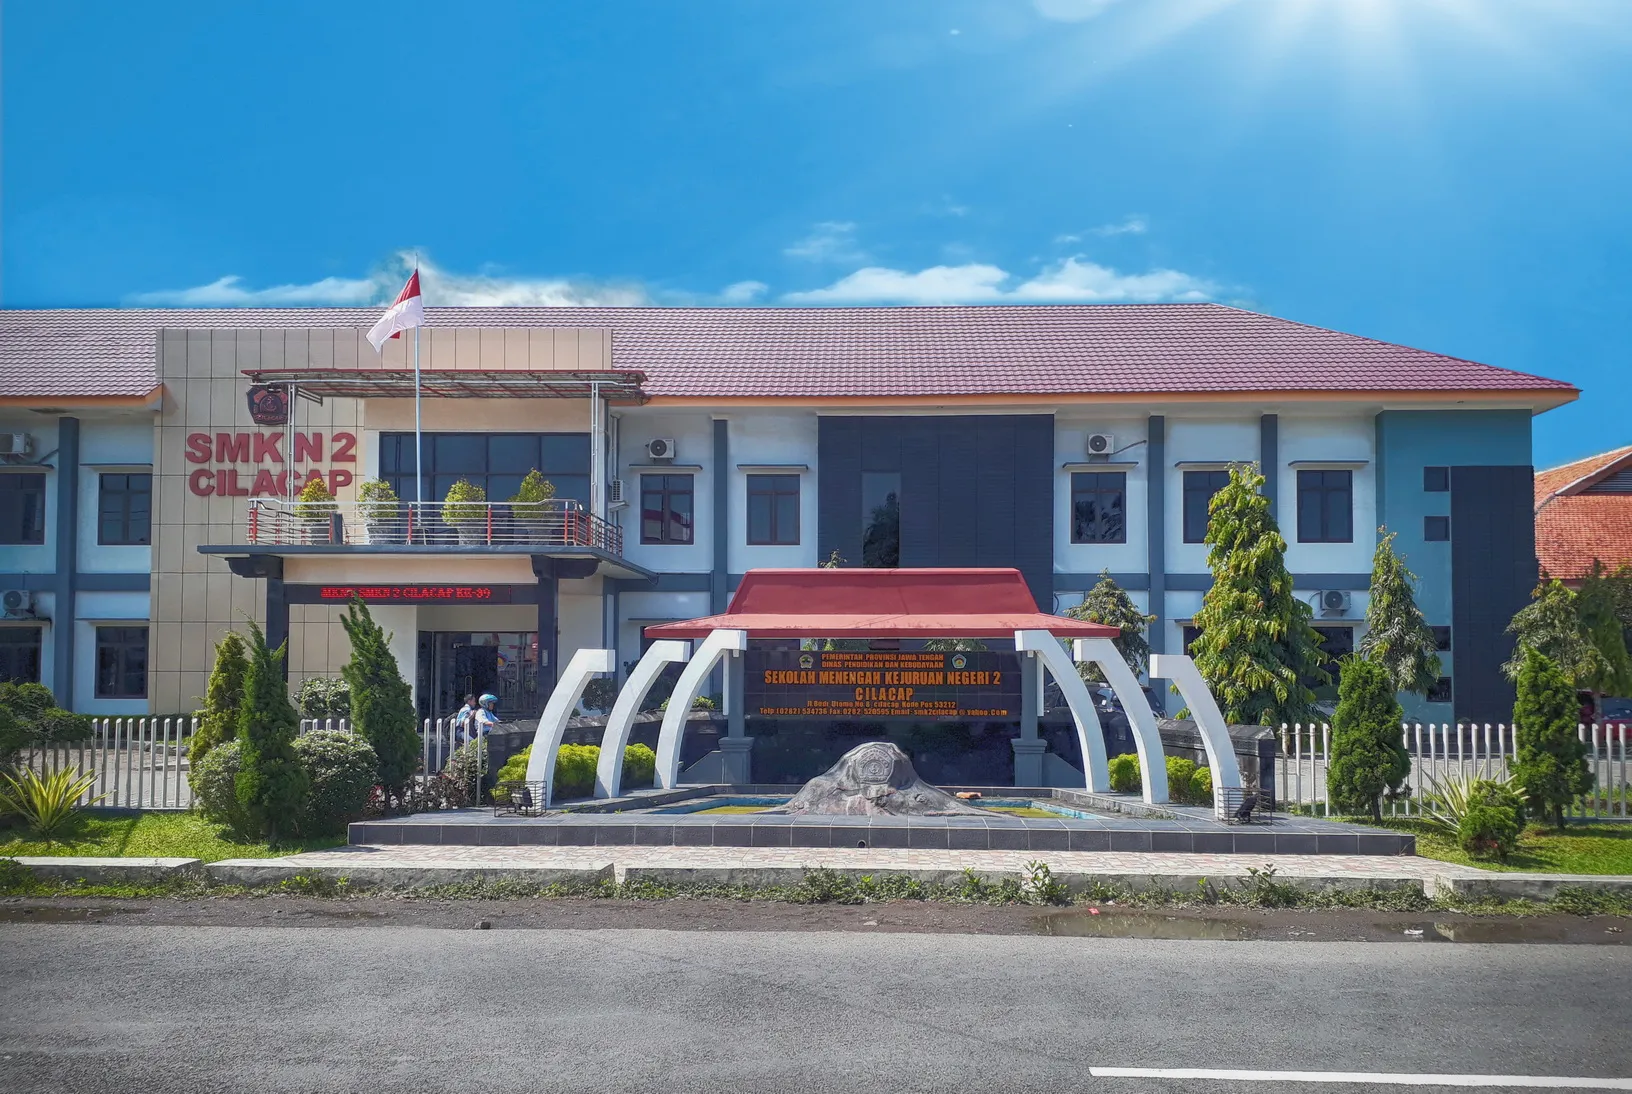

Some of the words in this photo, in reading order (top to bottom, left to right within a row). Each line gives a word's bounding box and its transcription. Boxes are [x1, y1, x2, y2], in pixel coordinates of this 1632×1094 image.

[331, 432, 357, 463] 2
[189, 469, 354, 497] CILACAP
[393, 587, 401, 598] 2
[403, 587, 454, 598] CILACAP
[764, 670, 816, 684] SEKOLAH
[819, 671, 881, 685] MENENGAH
[885, 671, 944, 685] KEJURUAN
[947, 671, 990, 685] NEGERI
[993, 671, 1001, 685] 2
[855, 687, 914, 701] CILACAP
